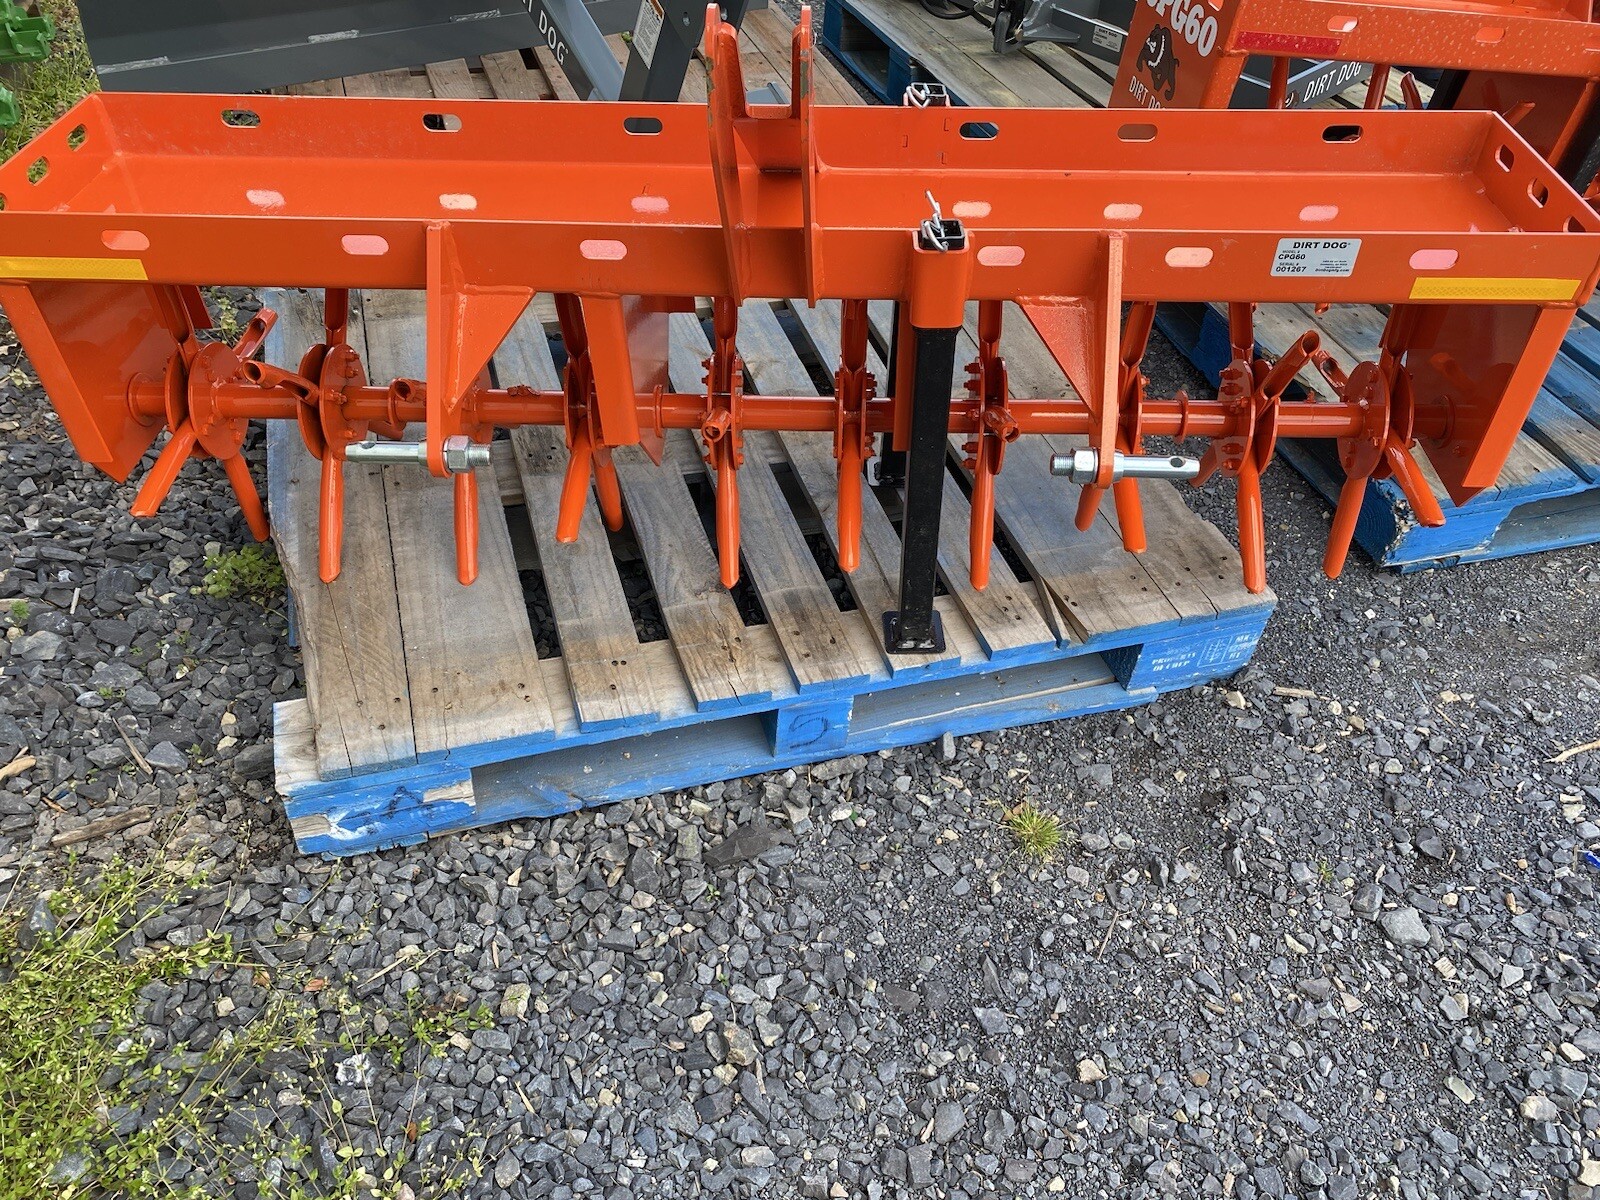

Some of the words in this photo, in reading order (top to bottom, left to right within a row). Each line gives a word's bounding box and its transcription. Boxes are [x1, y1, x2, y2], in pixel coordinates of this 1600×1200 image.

[538, 9, 566, 66] DOG
[1129, 75, 1149, 105] DIRT
[1303, 69, 1337, 103] DIRT
[1293, 241, 1320, 249] DIRT
[1322, 241, 1348, 249] DOG
